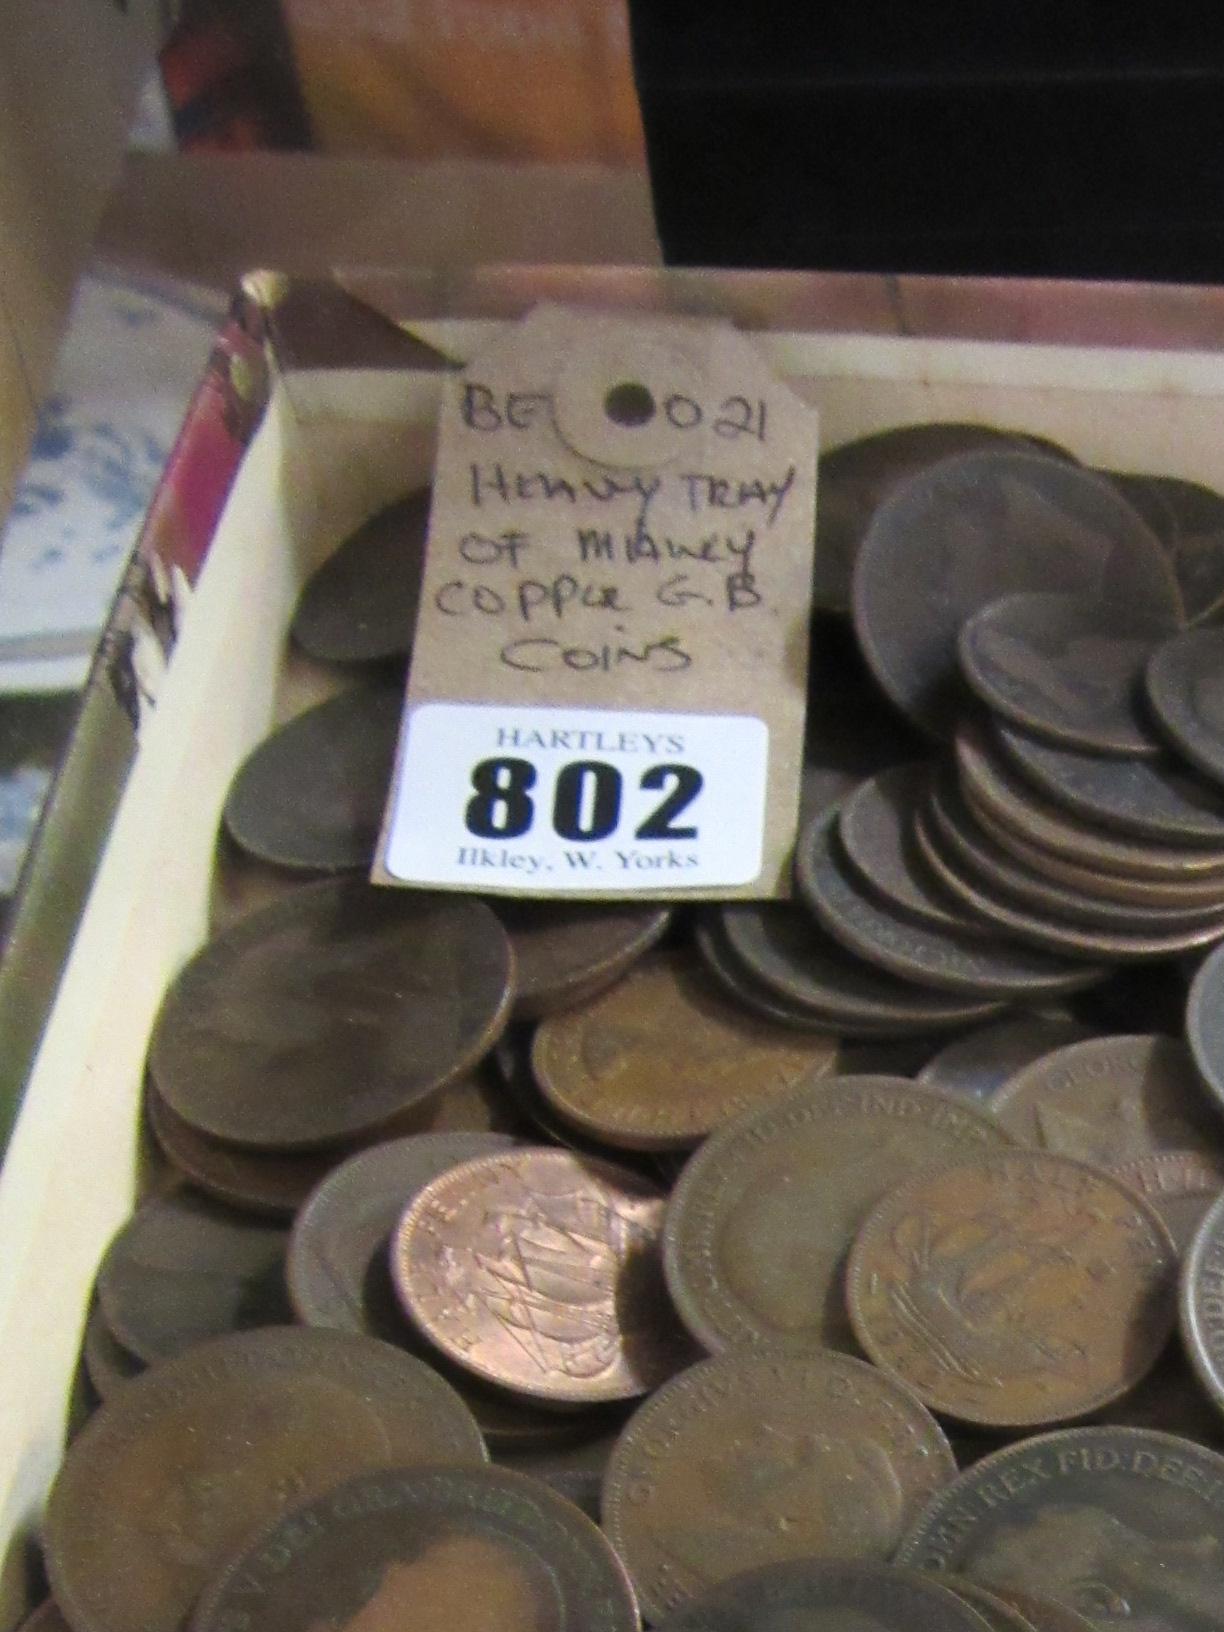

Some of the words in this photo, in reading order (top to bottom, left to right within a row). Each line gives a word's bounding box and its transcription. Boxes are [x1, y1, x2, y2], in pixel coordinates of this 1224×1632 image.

[665, 393, 767, 442] 021
[681, 464, 795, 527] TRAY
[459, 529, 529, 568] OF
[500, 624, 692, 673] COINS
[496, 726, 686, 755] HARTLEYS
[464, 756, 705, 843] 802
[457, 847, 553, 875] Ilkley,
[613, 849, 700, 872] Yorks
